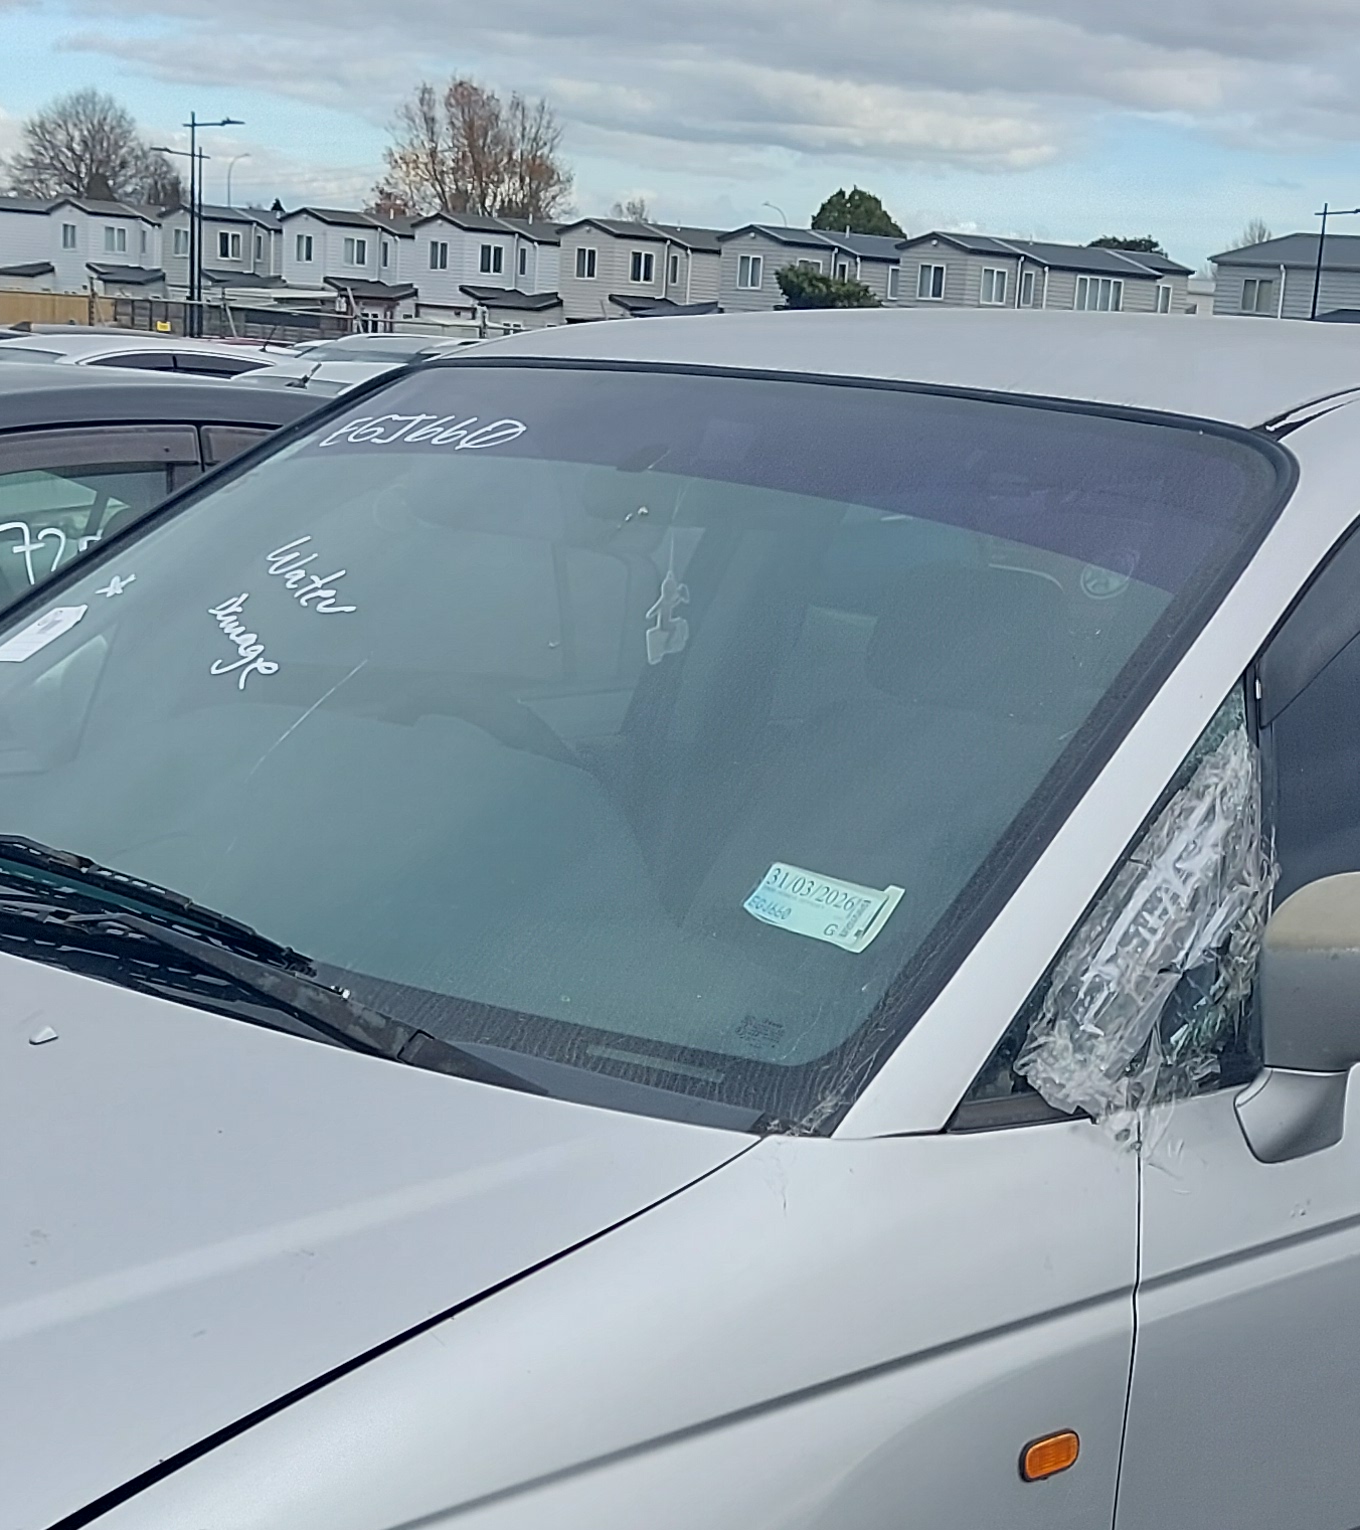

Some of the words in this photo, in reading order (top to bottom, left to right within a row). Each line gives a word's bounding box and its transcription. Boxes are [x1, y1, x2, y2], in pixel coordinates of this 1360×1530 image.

[319, 413, 527, 450] EGJ660
[266, 535, 357, 613] Water
[766, 867, 856, 912] 31/03/2026
